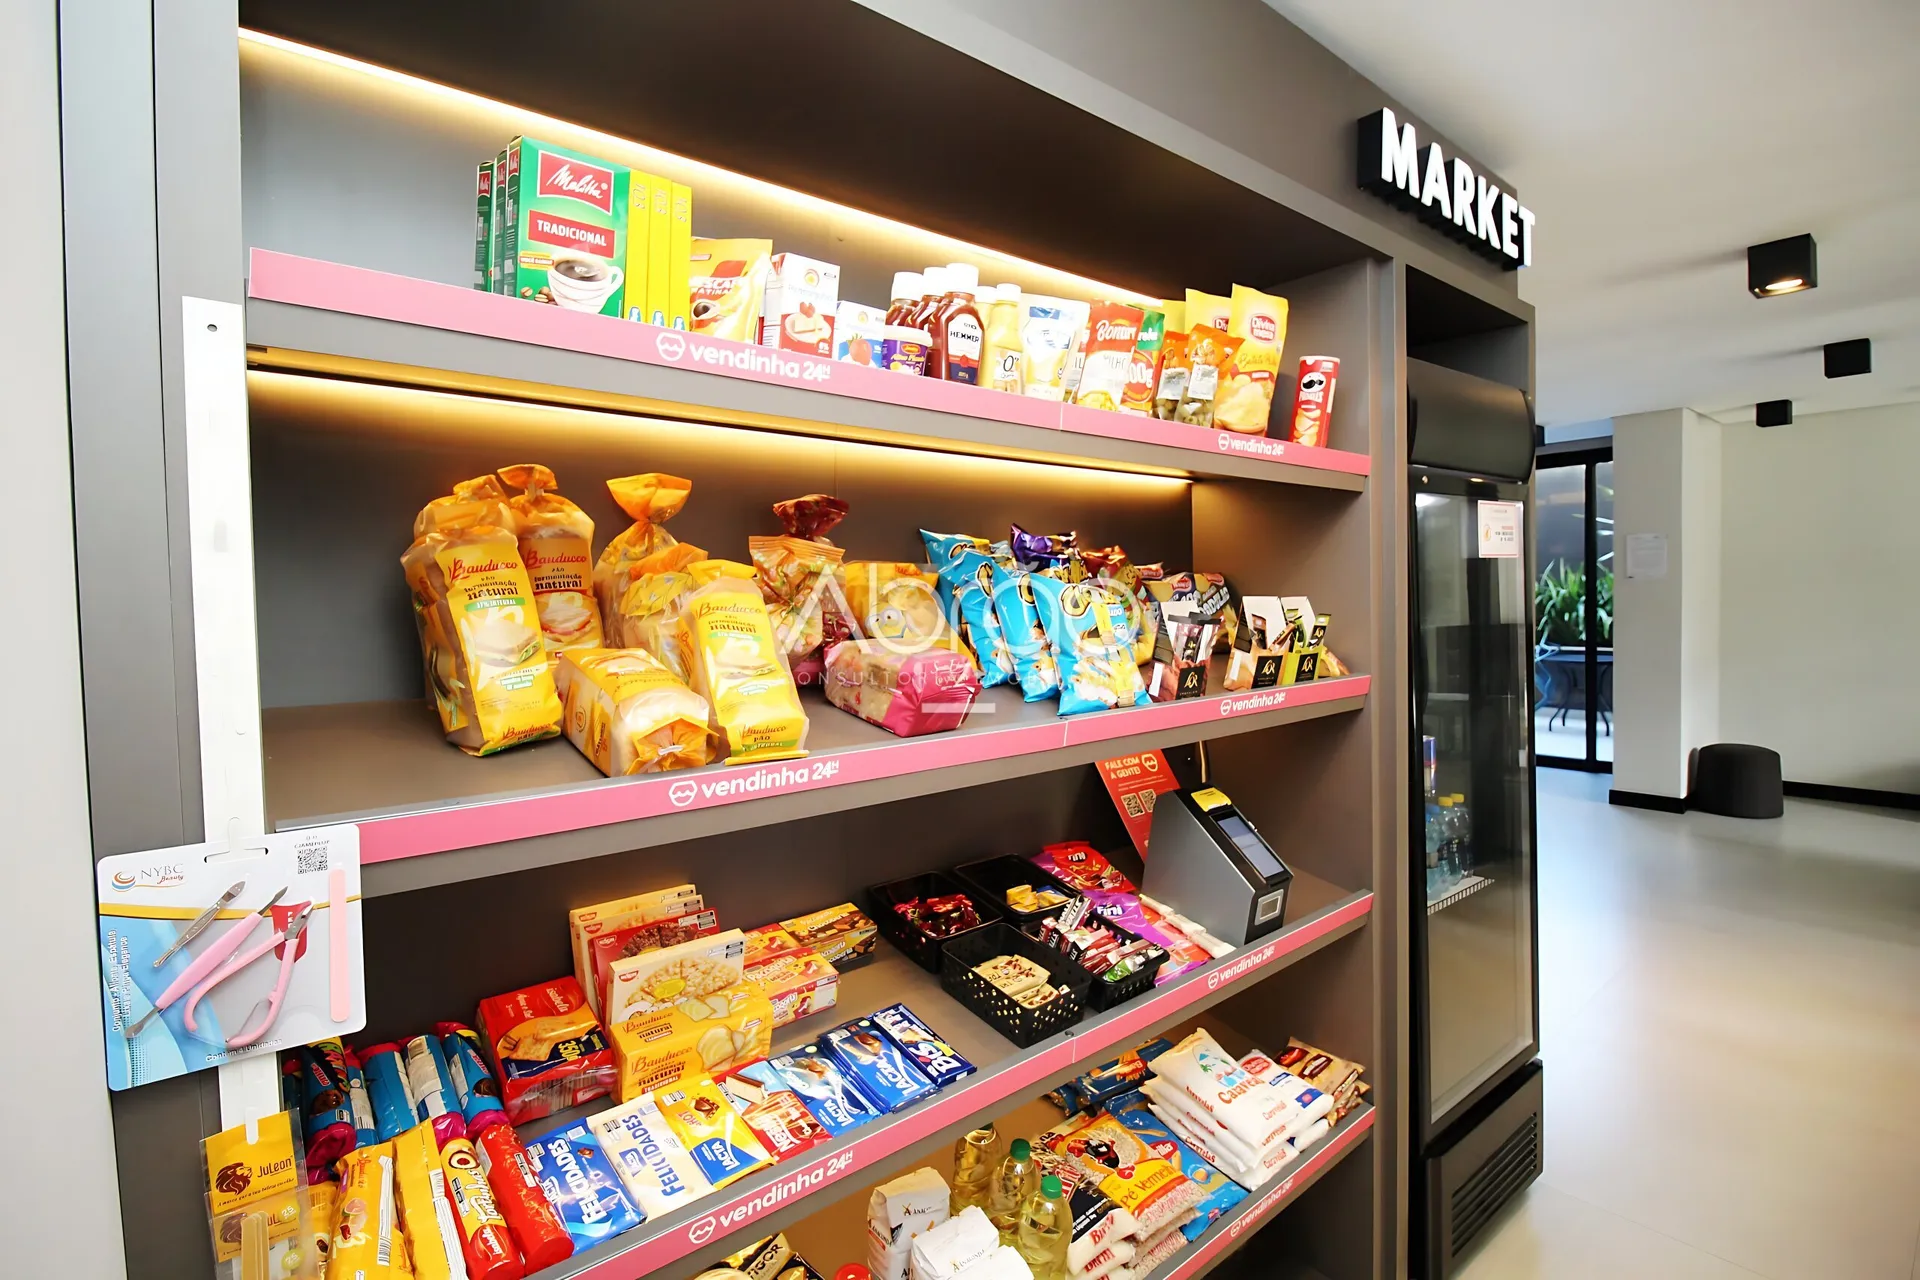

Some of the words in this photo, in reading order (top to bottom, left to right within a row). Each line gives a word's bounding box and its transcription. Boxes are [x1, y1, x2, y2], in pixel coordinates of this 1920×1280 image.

[546, 164, 605, 199] Melitta
[1382, 107, 1535, 267] MARKET
[537, 219, 607, 247] TRADICIONAL
[689, 342, 800, 379] vendinha
[1230, 437, 1273, 455] vendinha
[448, 557, 518, 582] Bauducco
[525, 550, 587, 570] Bauducco
[467, 586, 519, 601] natural
[535, 580, 583, 591] natural
[696, 602, 762, 620] Bauducco
[1232, 694, 1273, 712] vendinha
[1105, 758, 1122, 771] FALE
[1123, 755, 1140, 768] COM
[701, 766, 810, 801] vendinha
[140, 863, 184, 879] NYBC
[1096, 903, 1123, 917] Fini
[1219, 953, 1262, 981] vendinha
[632, 1046, 693, 1076] Bauducco
[875, 1058, 917, 1098] LACTA
[822, 1098, 855, 1128] LACTA
[257, 1157, 292, 1179] JuLeon
[622, 1115, 686, 1197] FELICIDADES
[711, 1140, 739, 1171] LACTA
[548, 1136, 608, 1224] FELICIDADES
[720, 1167, 824, 1226] vendinha
[1120, 1188, 1139, 1208] Pé
[1240, 1188, 1283, 1228] vendinha
